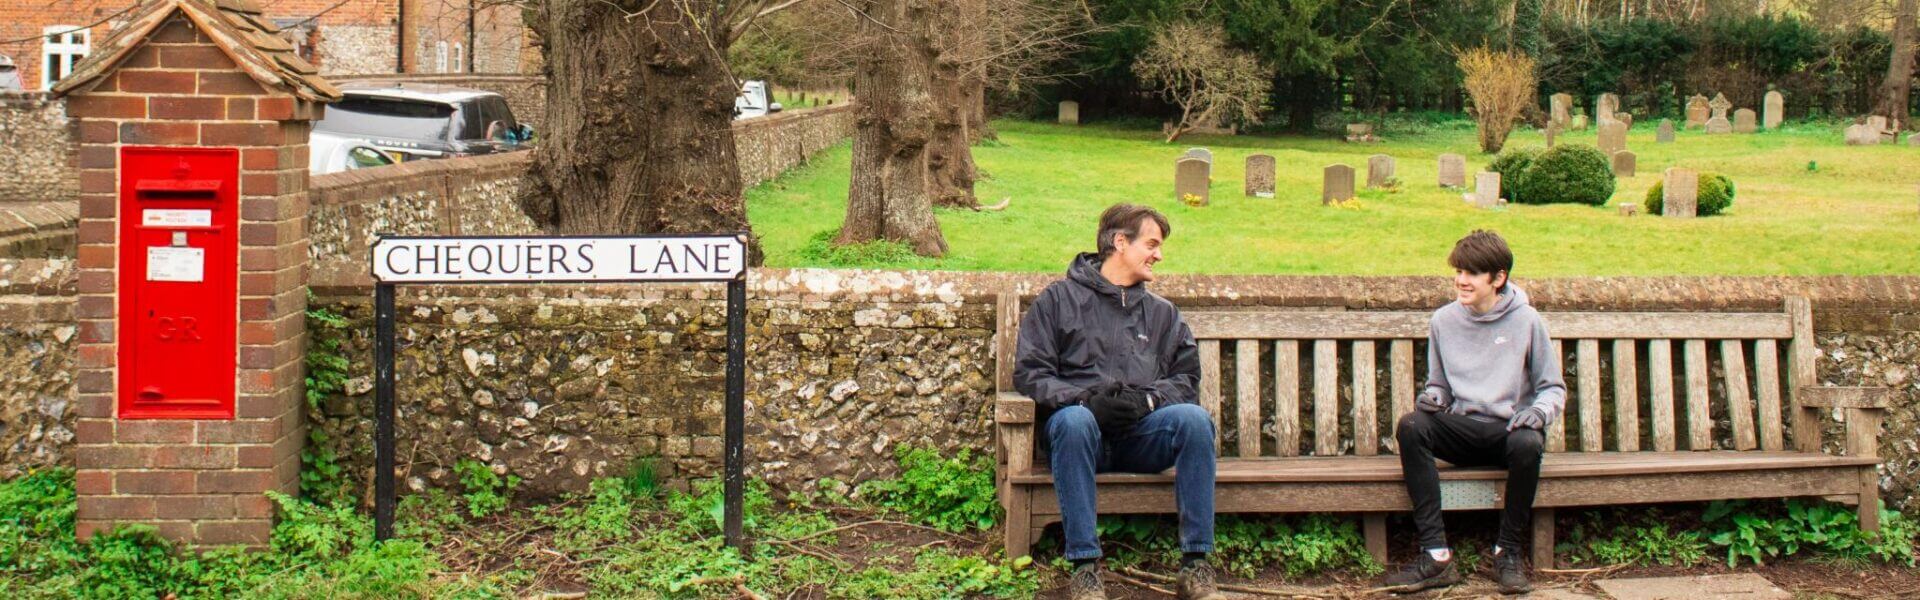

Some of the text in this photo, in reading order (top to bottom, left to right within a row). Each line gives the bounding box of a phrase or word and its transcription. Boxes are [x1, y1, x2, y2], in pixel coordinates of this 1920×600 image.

[377, 140, 417, 148] ROVER
[386, 244, 731, 275] CHEQUERS LANE
[158, 316, 202, 340] GR
